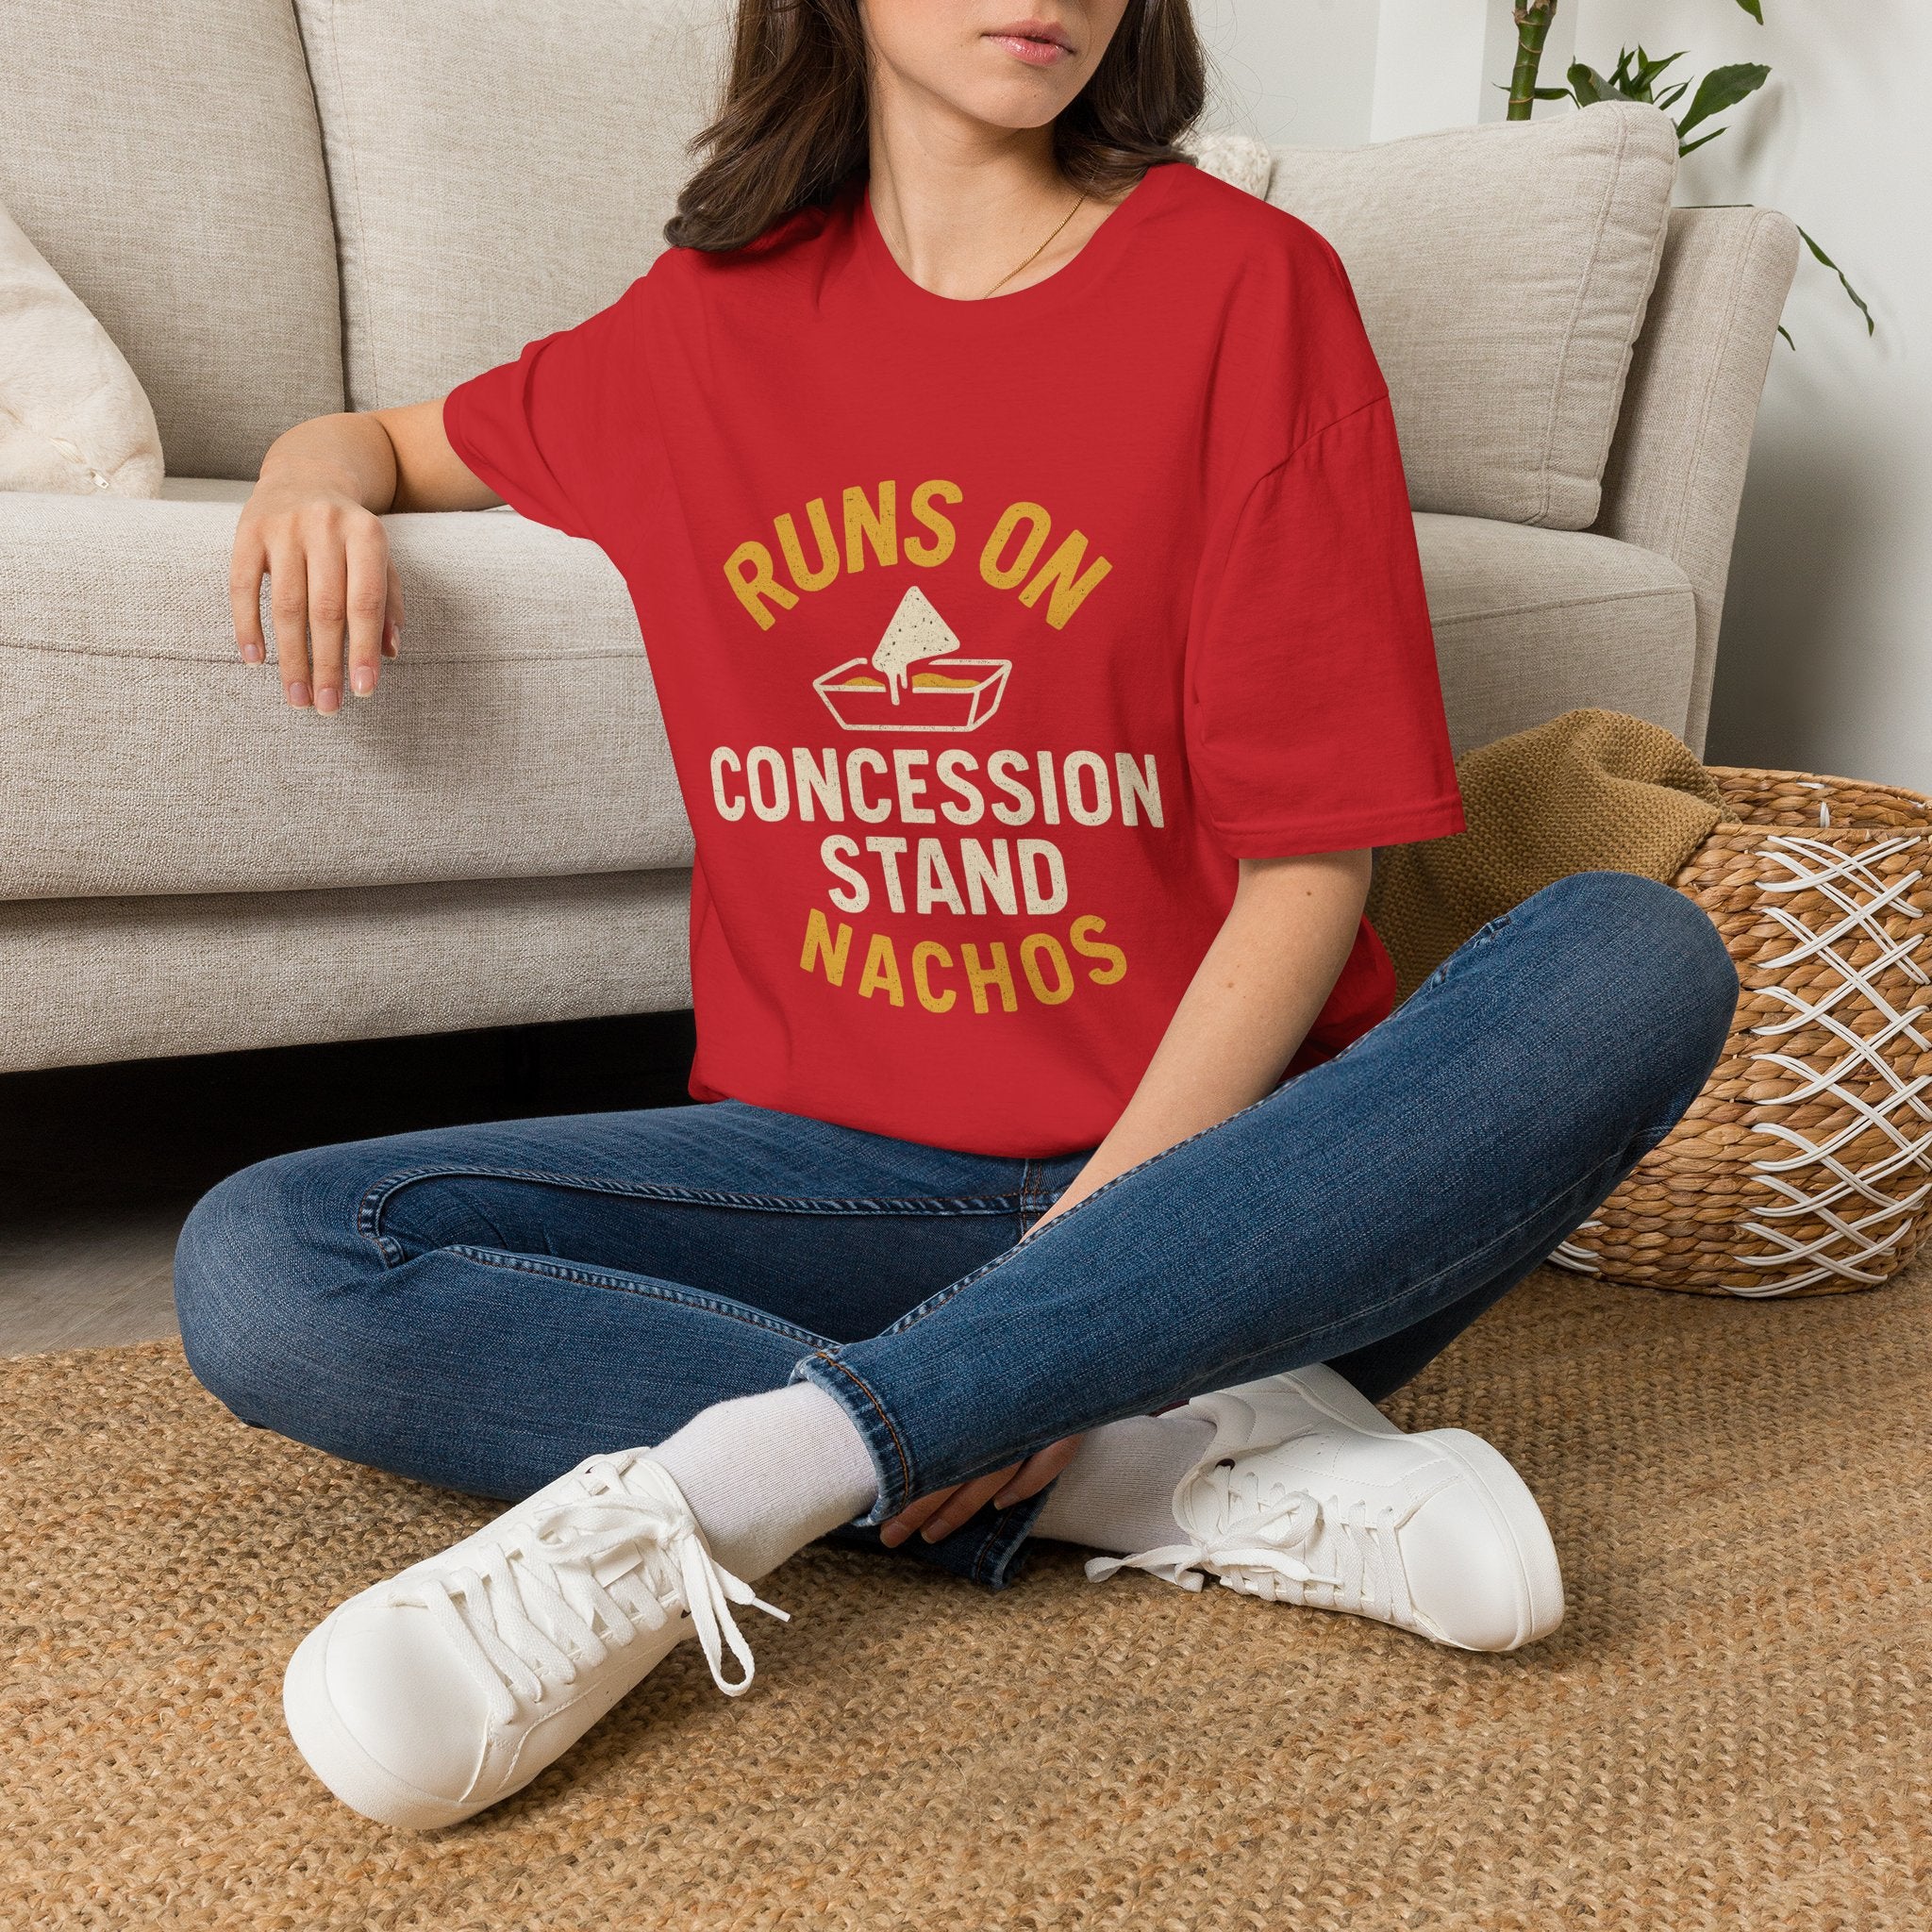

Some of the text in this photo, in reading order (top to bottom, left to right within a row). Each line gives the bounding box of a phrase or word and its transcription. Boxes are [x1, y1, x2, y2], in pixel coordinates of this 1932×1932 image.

[723, 479, 1113, 631] RUNS ON
[709, 745, 1165, 828] CONCESSION
[820, 834, 1069, 916] STAND
[799, 908, 1127, 1014] NACHOS
